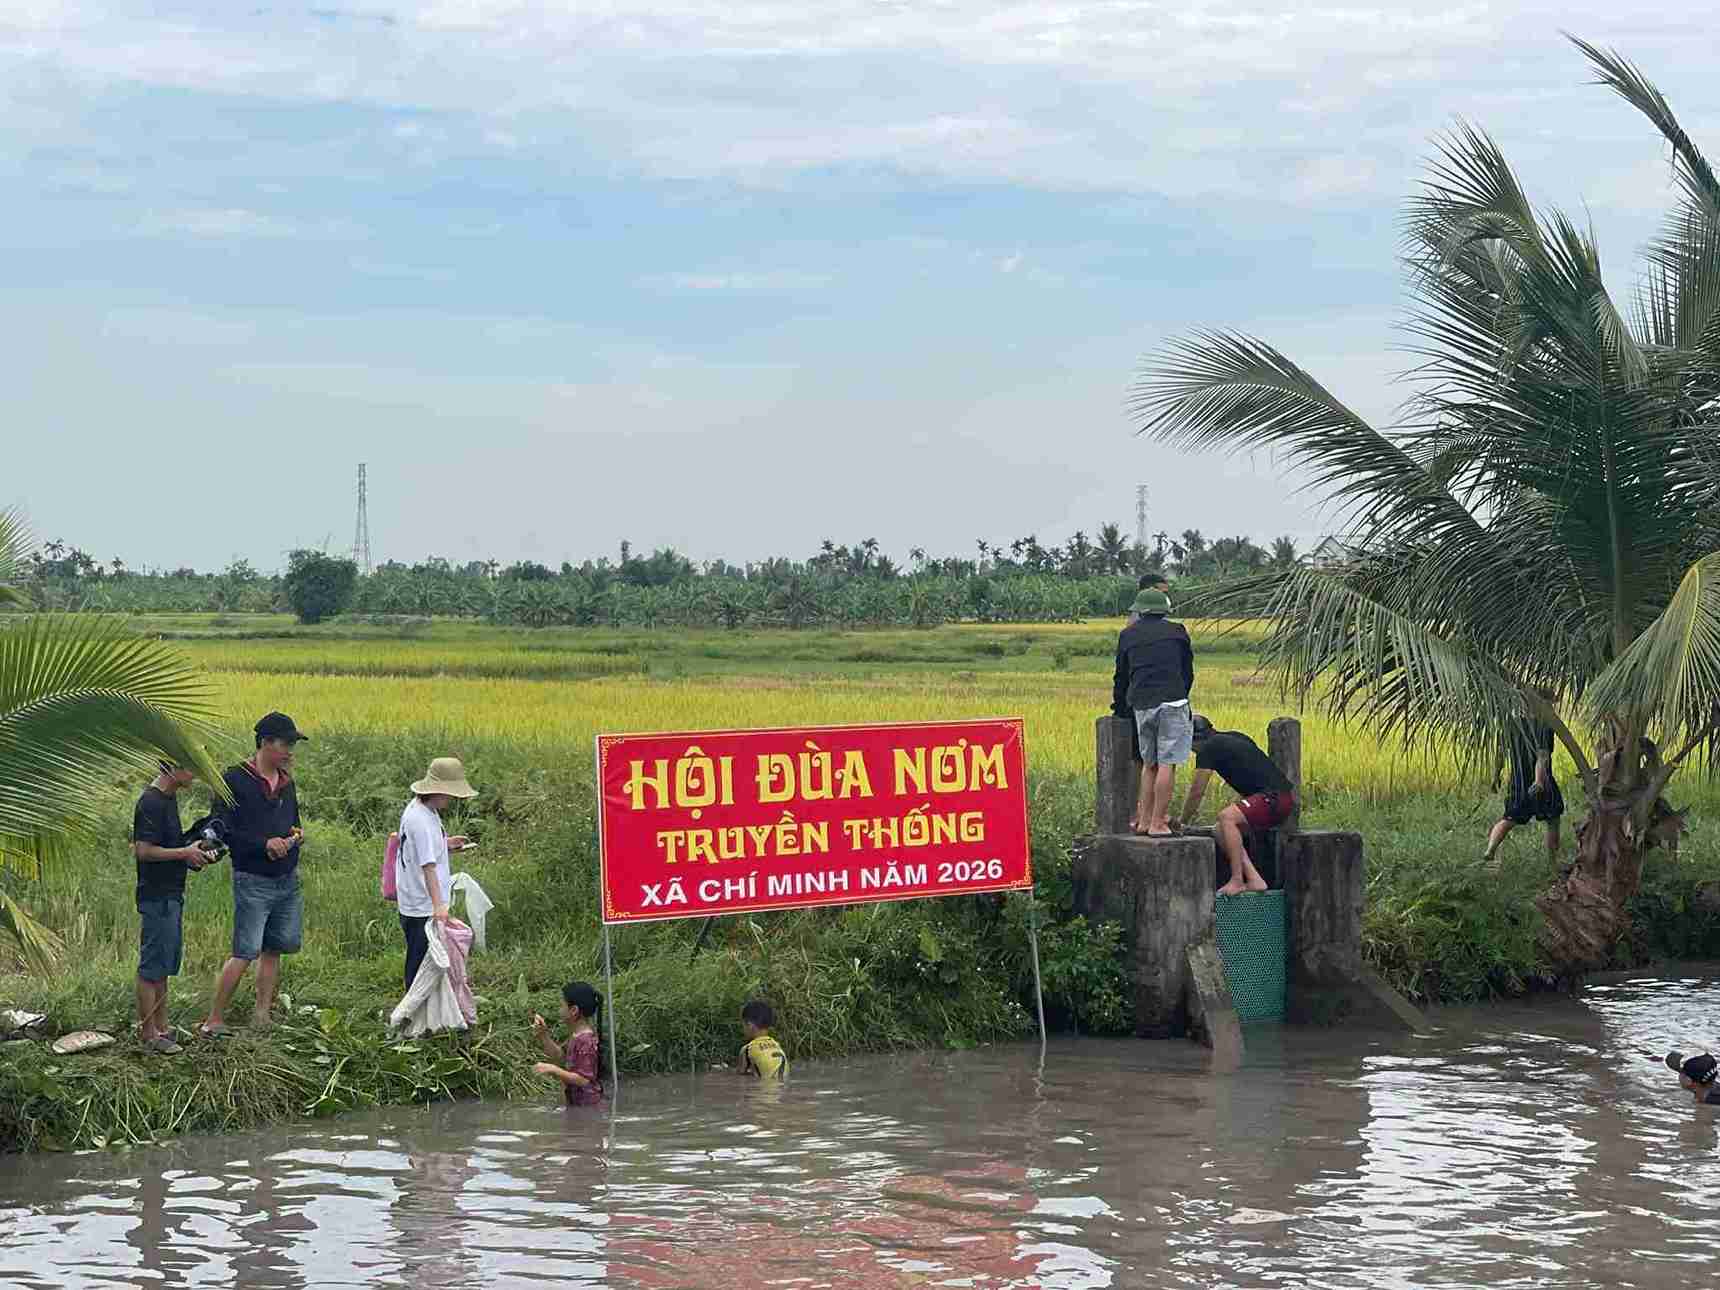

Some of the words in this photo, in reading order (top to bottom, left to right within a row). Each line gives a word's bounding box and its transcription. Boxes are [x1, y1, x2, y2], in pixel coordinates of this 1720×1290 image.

[622, 745, 735, 821] HỘI
[754, 739, 874, 805] ĐÙA
[892, 738, 1009, 797] NƠM
[656, 809, 829, 865] TRUYỀN
[843, 802, 985, 851] THỐNG
[640, 877, 689, 907] XÃ
[698, 870, 758, 903] CHÍ
[767, 868, 850, 898] MINH
[860, 862, 928, 892] NĂM
[937, 857, 1004, 884] 2026
